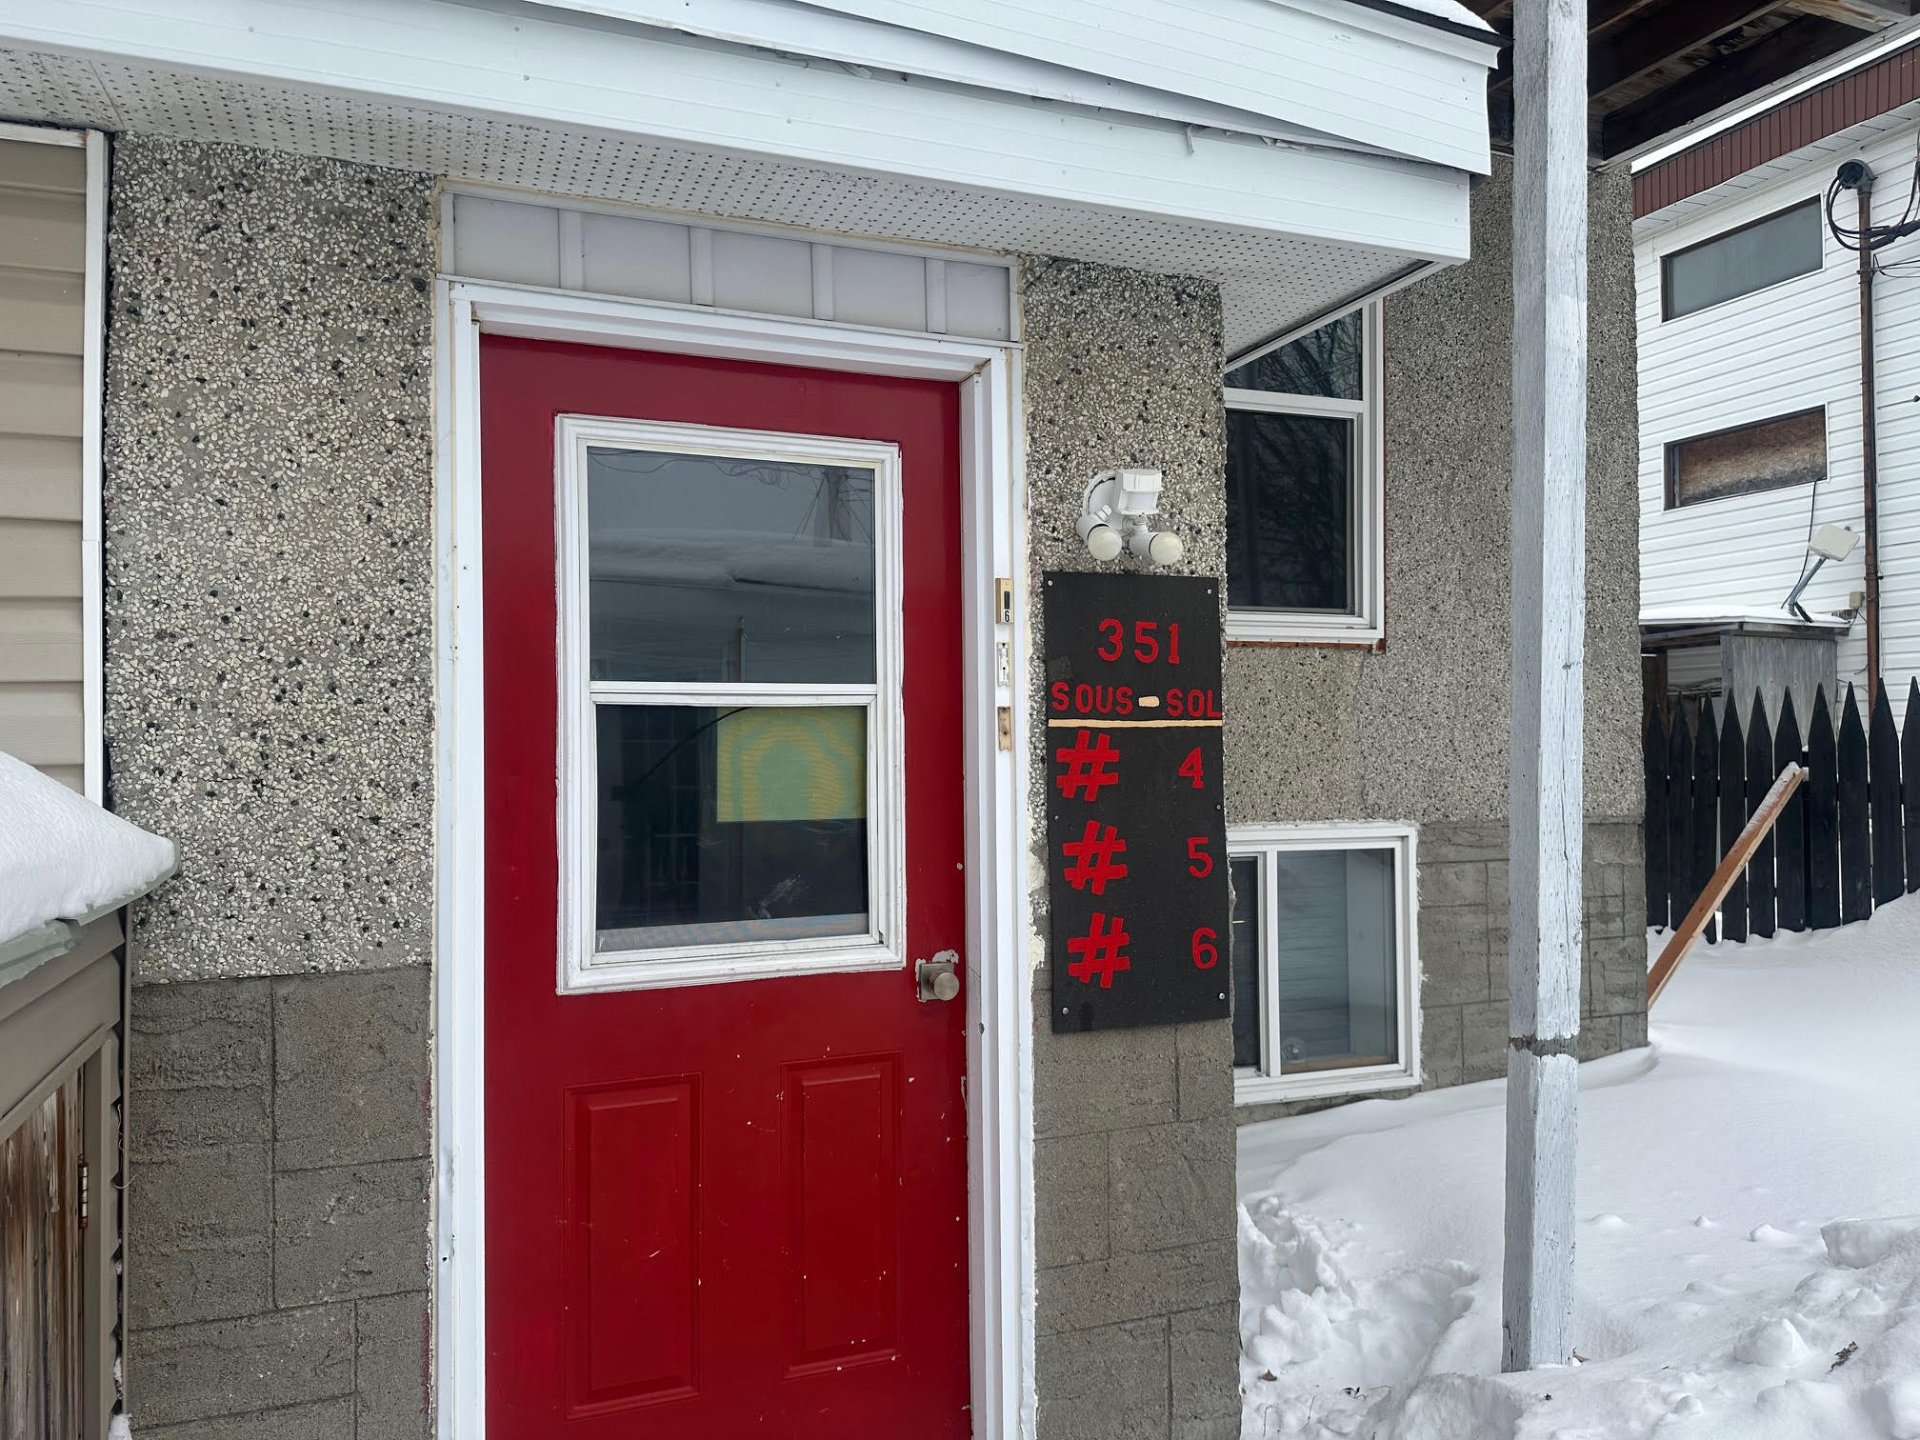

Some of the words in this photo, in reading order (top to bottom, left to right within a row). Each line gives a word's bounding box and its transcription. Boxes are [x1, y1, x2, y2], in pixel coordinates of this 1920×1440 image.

[1004, 610, 1010, 623] 6
[1098, 618, 1180, 664] 351
[1056, 730, 1119, 801] #
[1179, 747, 1204, 788] 4
[1062, 820, 1128, 895] #
[1188, 837, 1213, 878] 5
[1067, 912, 1130, 988] #
[1192, 928, 1218, 970] 6
